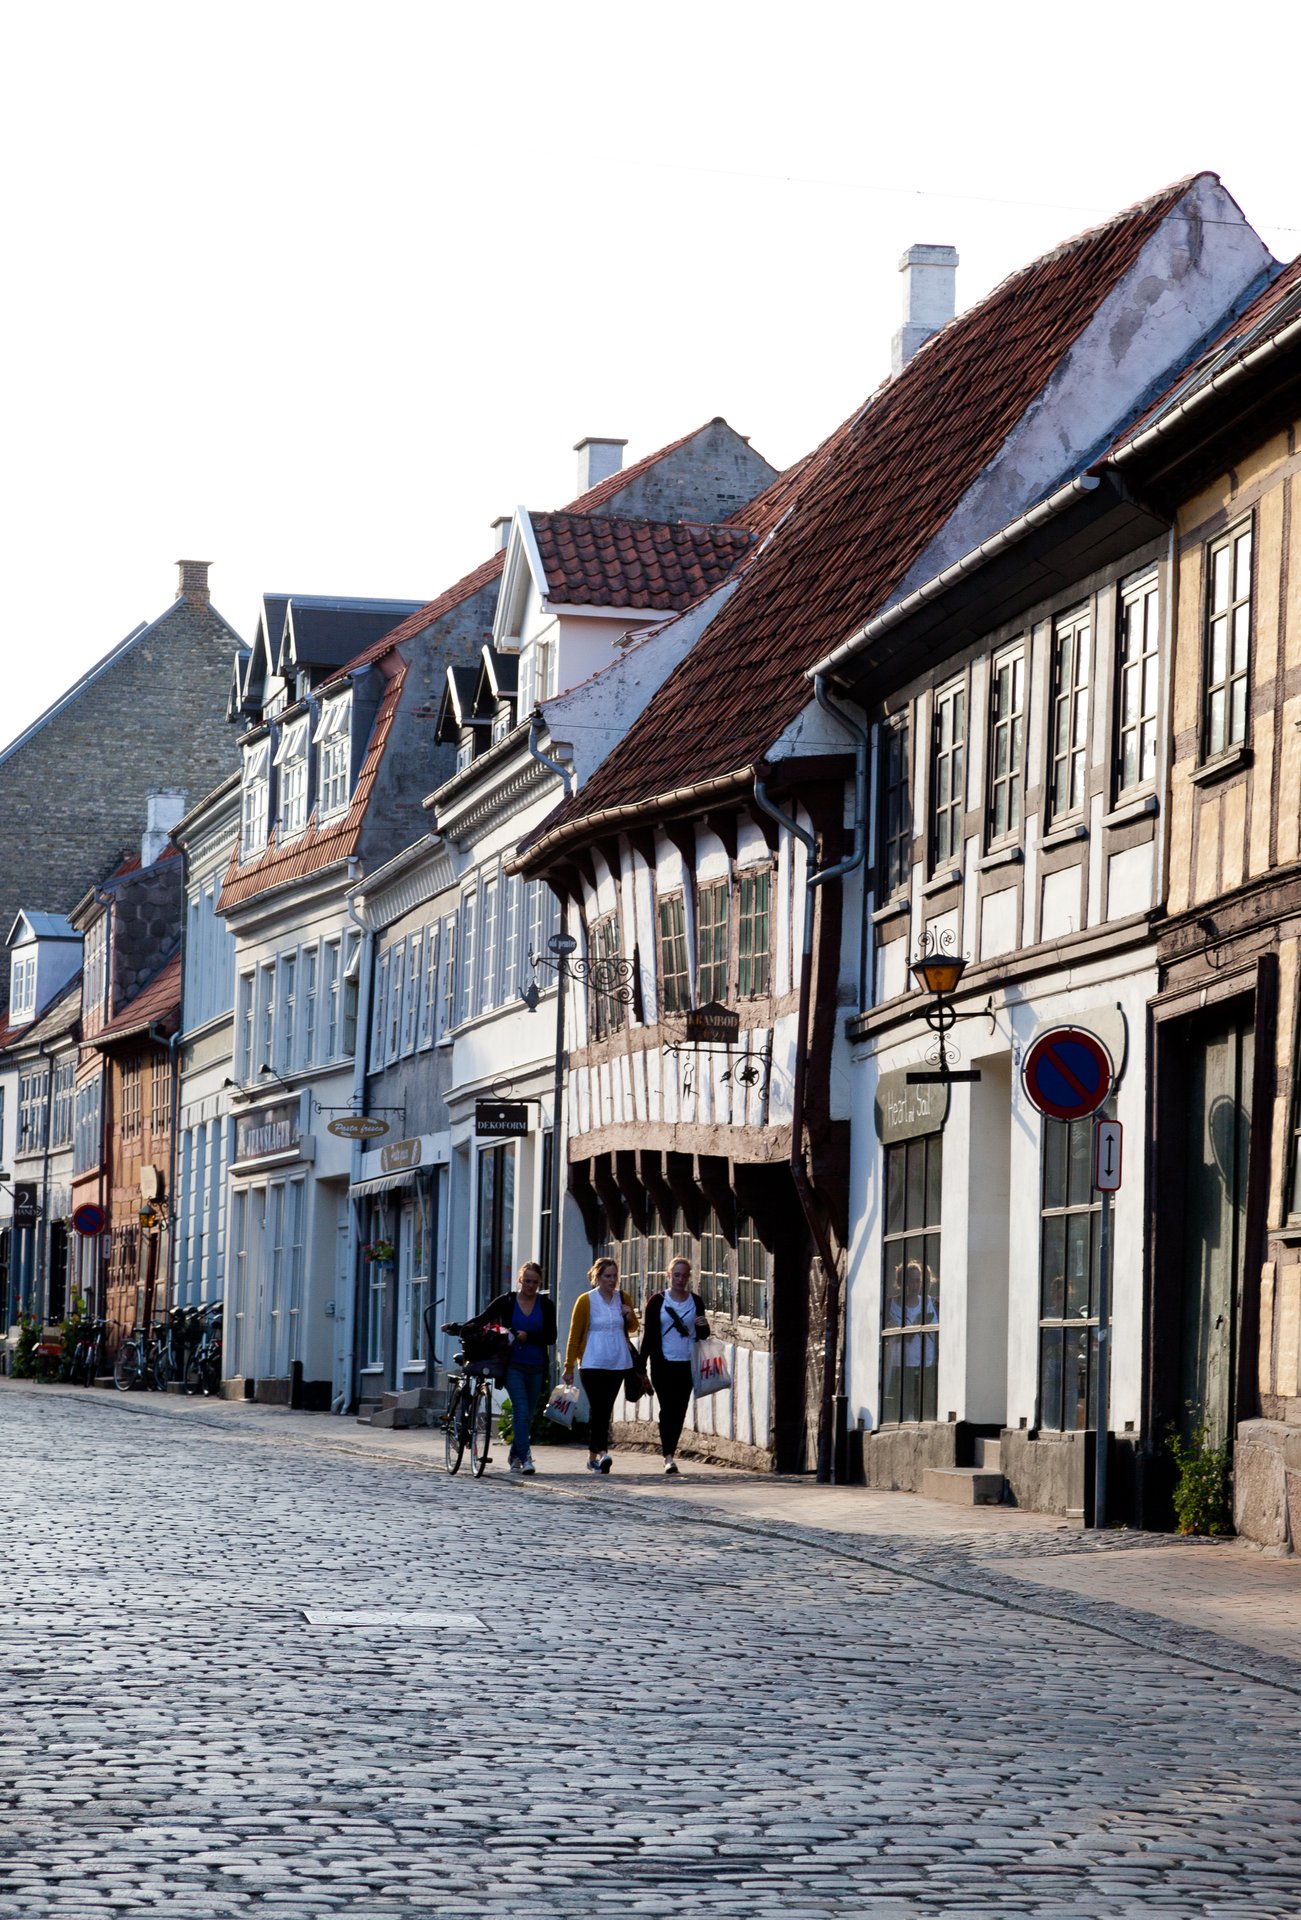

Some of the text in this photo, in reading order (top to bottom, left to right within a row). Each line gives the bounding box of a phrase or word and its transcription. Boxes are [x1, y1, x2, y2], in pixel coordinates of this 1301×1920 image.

[887, 1088, 908, 1128] Heart
[334, 1123, 385, 1134] Pasta fresca
[477, 1121, 526, 1130] DEKOFORM
